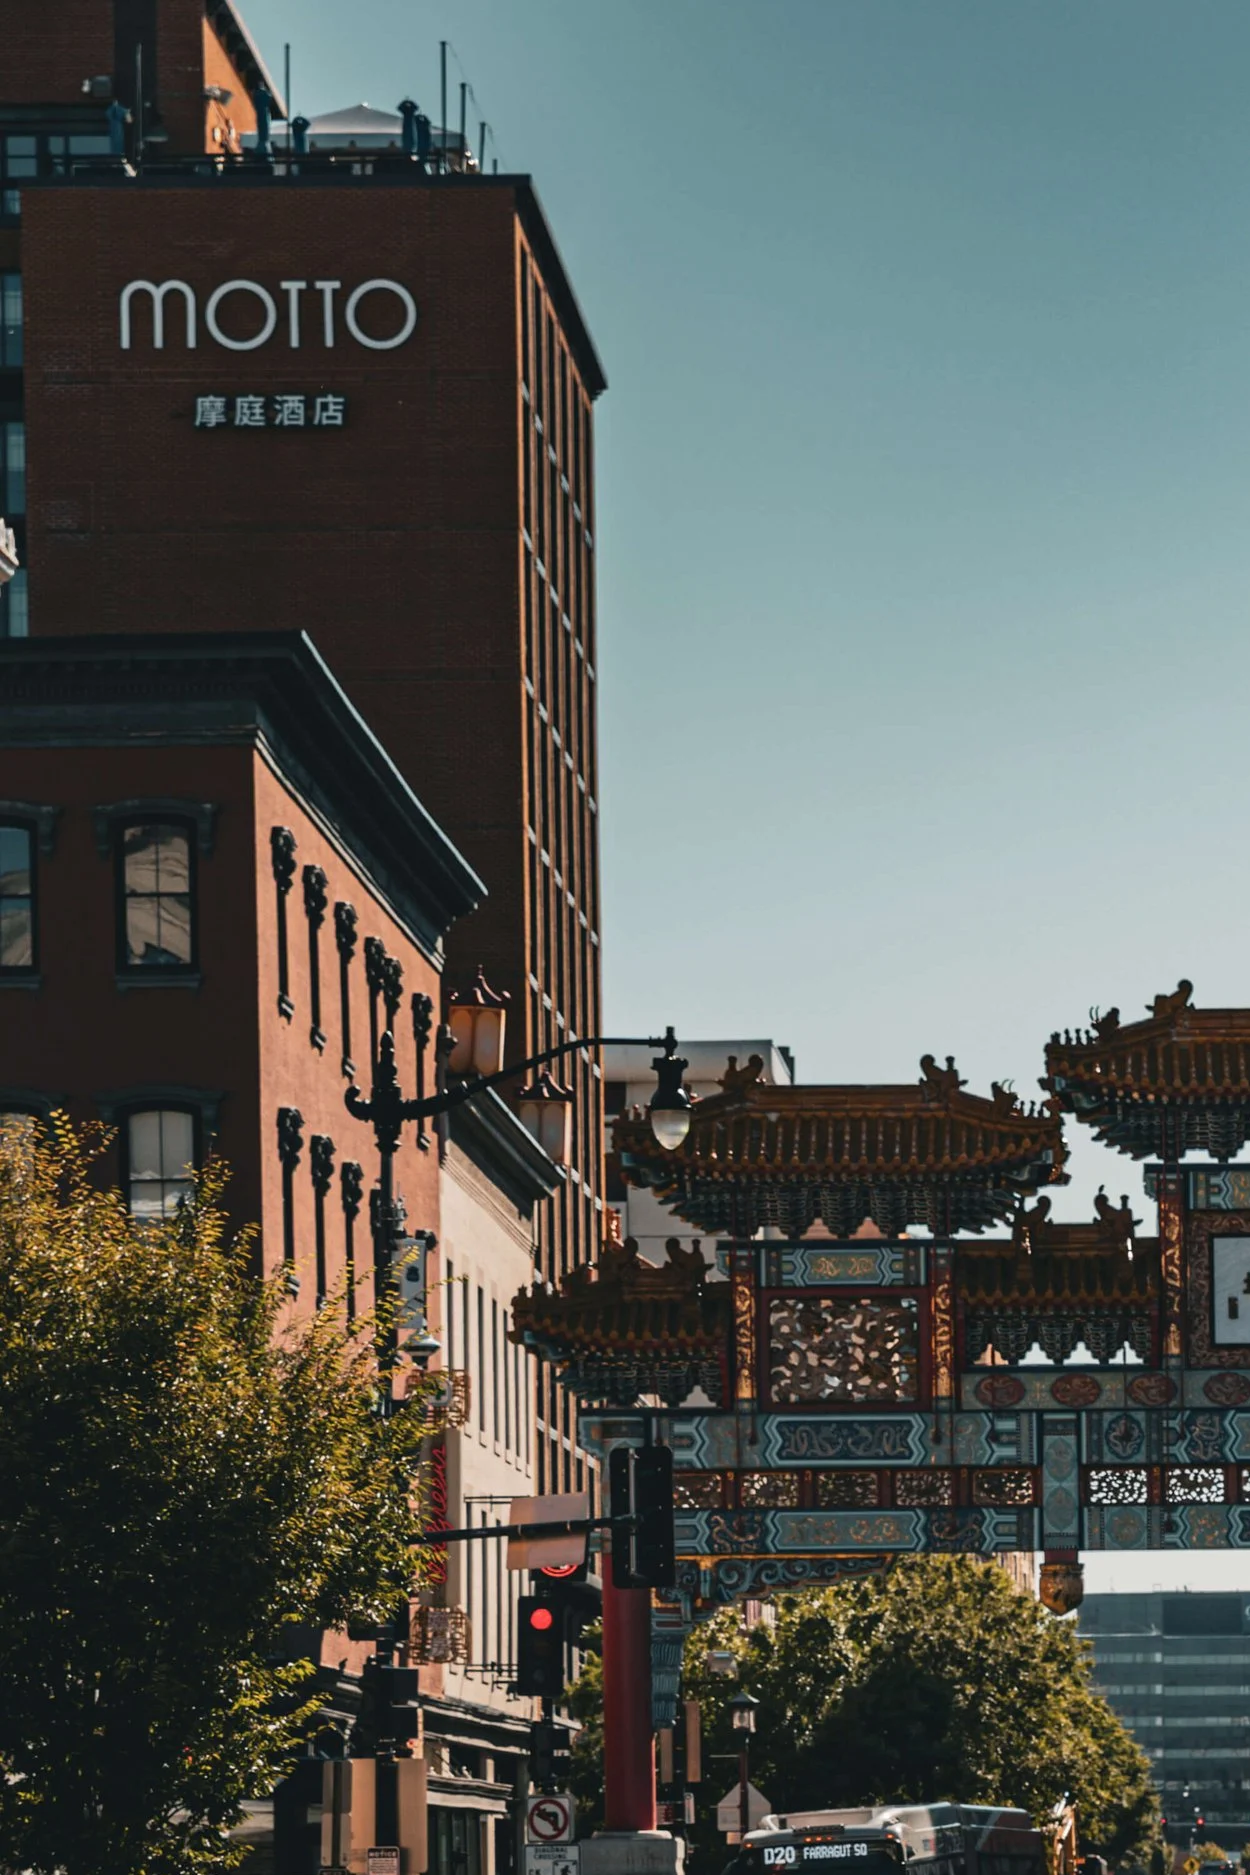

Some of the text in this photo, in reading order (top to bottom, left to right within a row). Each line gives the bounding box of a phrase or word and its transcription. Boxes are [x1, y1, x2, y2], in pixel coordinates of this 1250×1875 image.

[195, 395, 345, 428] 摩庭酒店
[764, 1846, 796, 1865] D20
[803, 1844, 851, 1859] FARRAGUT
